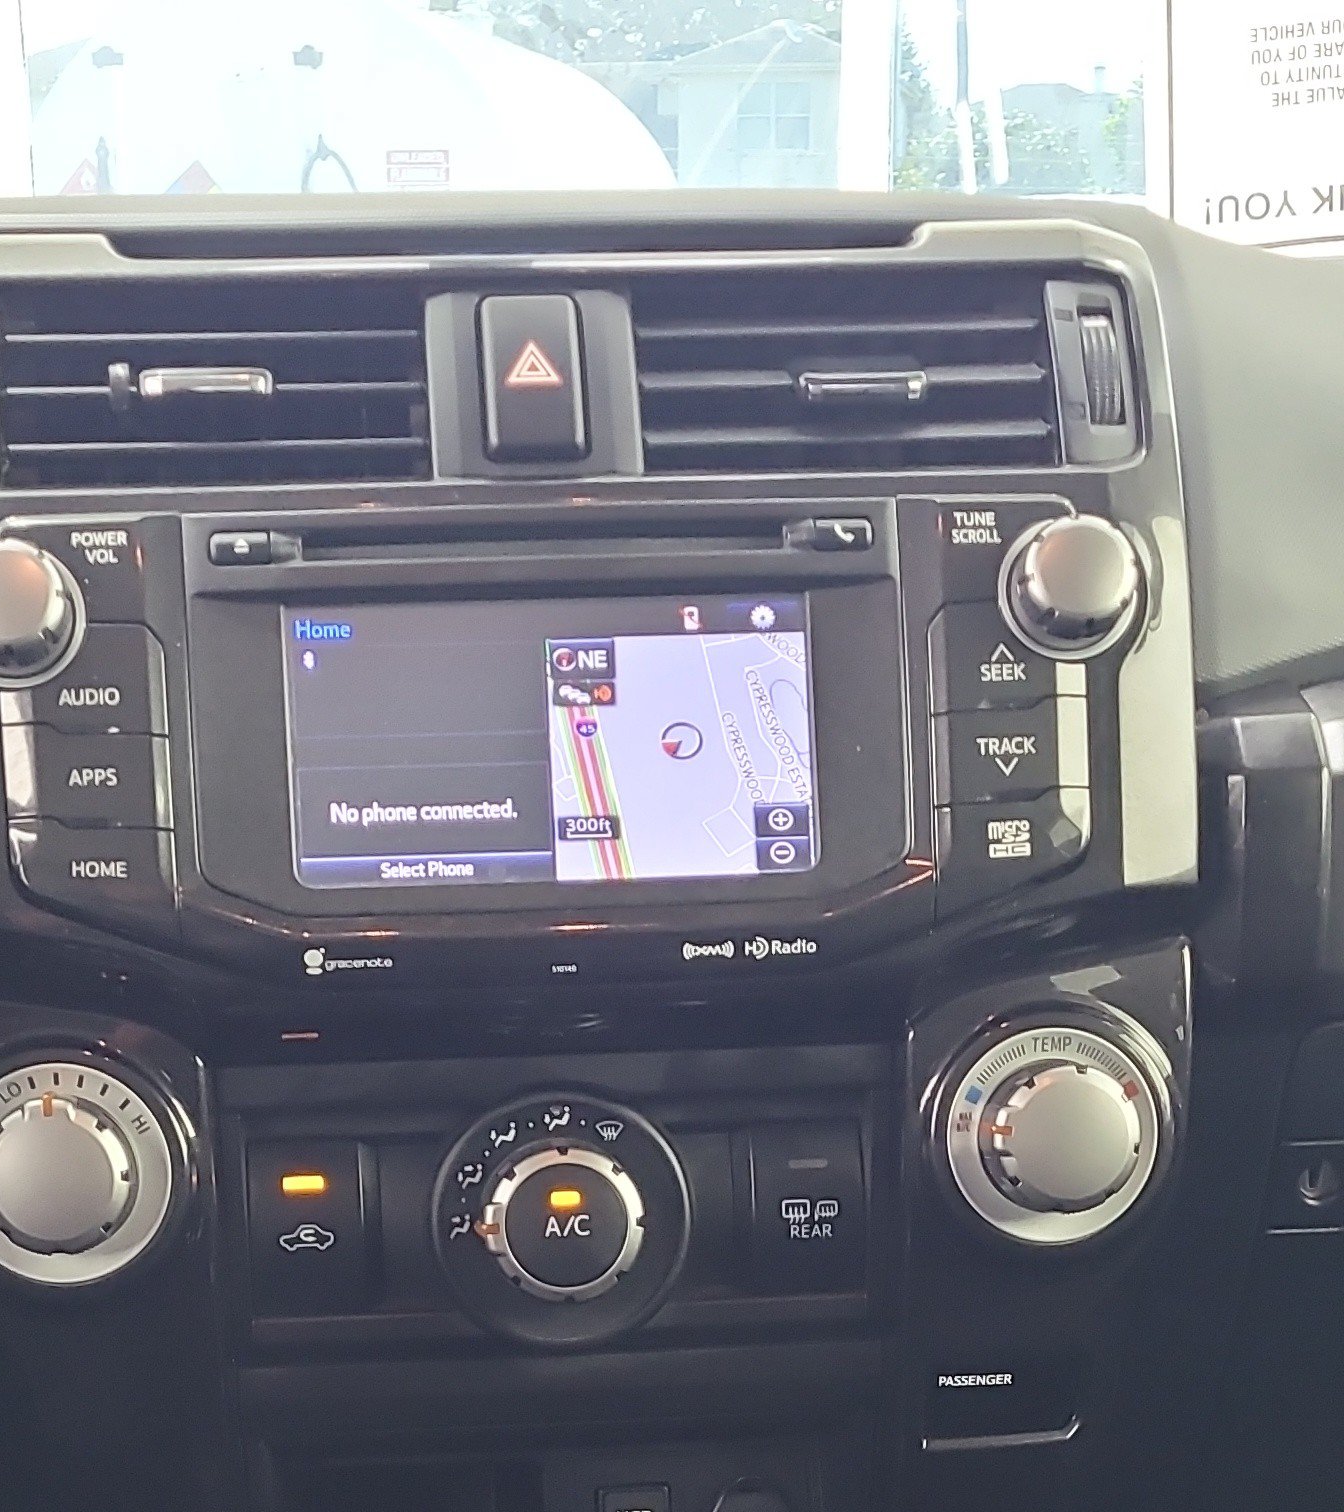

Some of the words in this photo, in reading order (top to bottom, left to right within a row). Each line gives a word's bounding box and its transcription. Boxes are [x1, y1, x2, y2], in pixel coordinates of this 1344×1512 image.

[1250, 21, 1316, 43] VEHICLE
[1251, 48, 1283, 65] YOU
[1288, 44, 1308, 61] OF
[1260, 70, 1281, 86] TO
[1271, 90, 1301, 108] THE
[1205, 189, 1298, 226] YOU!
[952, 511, 997, 527] TUNE
[70, 529, 128, 549] POWER
[951, 528, 1003, 544] SCROLL
[84, 548, 119, 566] VOL
[294, 618, 351, 640] Home
[577, 649, 609, 669] NE
[979, 662, 1027, 682] SEEK
[58, 686, 121, 707] AUDIO
[745, 669, 795, 766] CYPRESSWOOD
[578, 722, 596, 734] 45
[976, 736, 1037, 756] TRACK
[68, 767, 118, 787] APPS
[329, 801, 359, 824] No
[361, 801, 418, 827] phone
[419, 797, 518, 821] connected.
[565, 817, 611, 833] 300ft
[70, 859, 129, 879] HOME
[379, 861, 426, 879] Select
[427, 860, 474, 878] Phone
[771, 937, 817, 956] Radio
[1031, 1036, 1072, 1053] TEMP
[130, 1114, 151, 1135] HI
[544, 1213, 591, 1238] A/C
[790, 1223, 833, 1239] REAR
[938, 1373, 1013, 1388] PASSENGER
